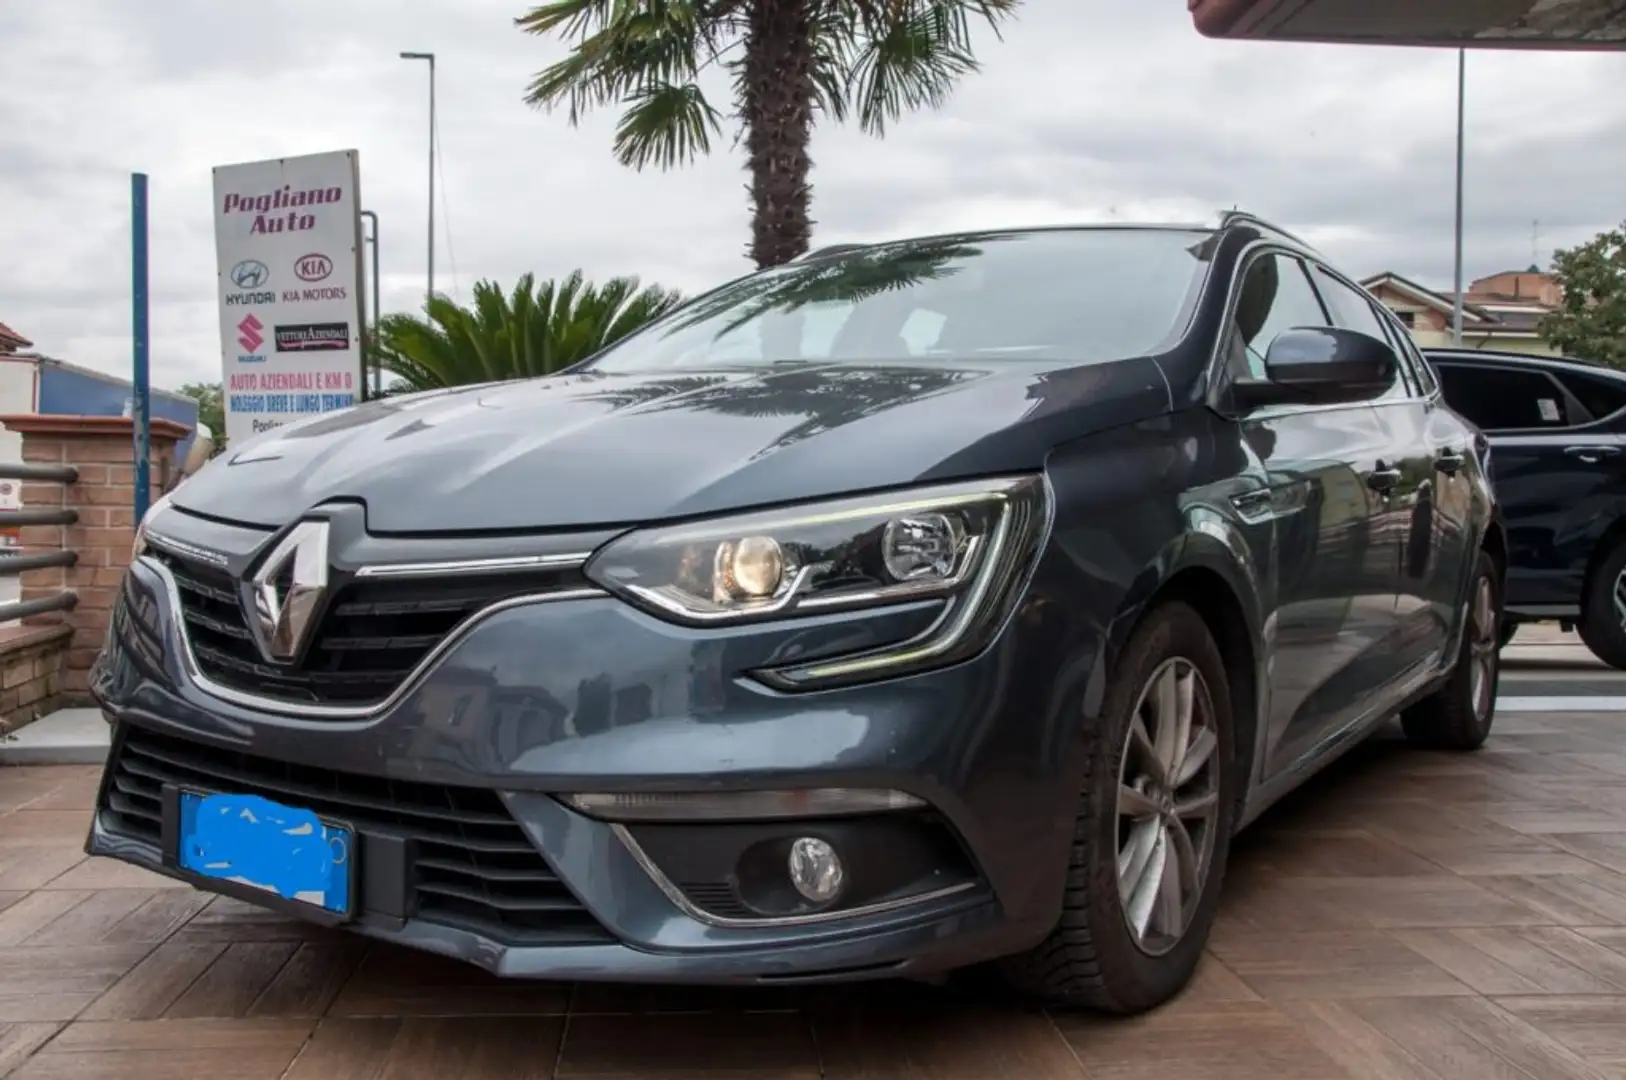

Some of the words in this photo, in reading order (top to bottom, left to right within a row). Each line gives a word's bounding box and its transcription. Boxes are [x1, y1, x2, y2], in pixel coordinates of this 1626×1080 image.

[224, 184, 342, 214] Pogliano
[250, 212, 316, 235] Auto
[301, 260, 326, 275] KIA
[226, 292, 276, 305] HYUNDAI
[282, 290, 300, 303] KIA
[303, 287, 347, 301] MOTORS
[230, 373, 257, 390] AUTO
[261, 372, 312, 390] AZIENDALI
[316, 372, 322, 389] E
[325, 372, 342, 389] KM
